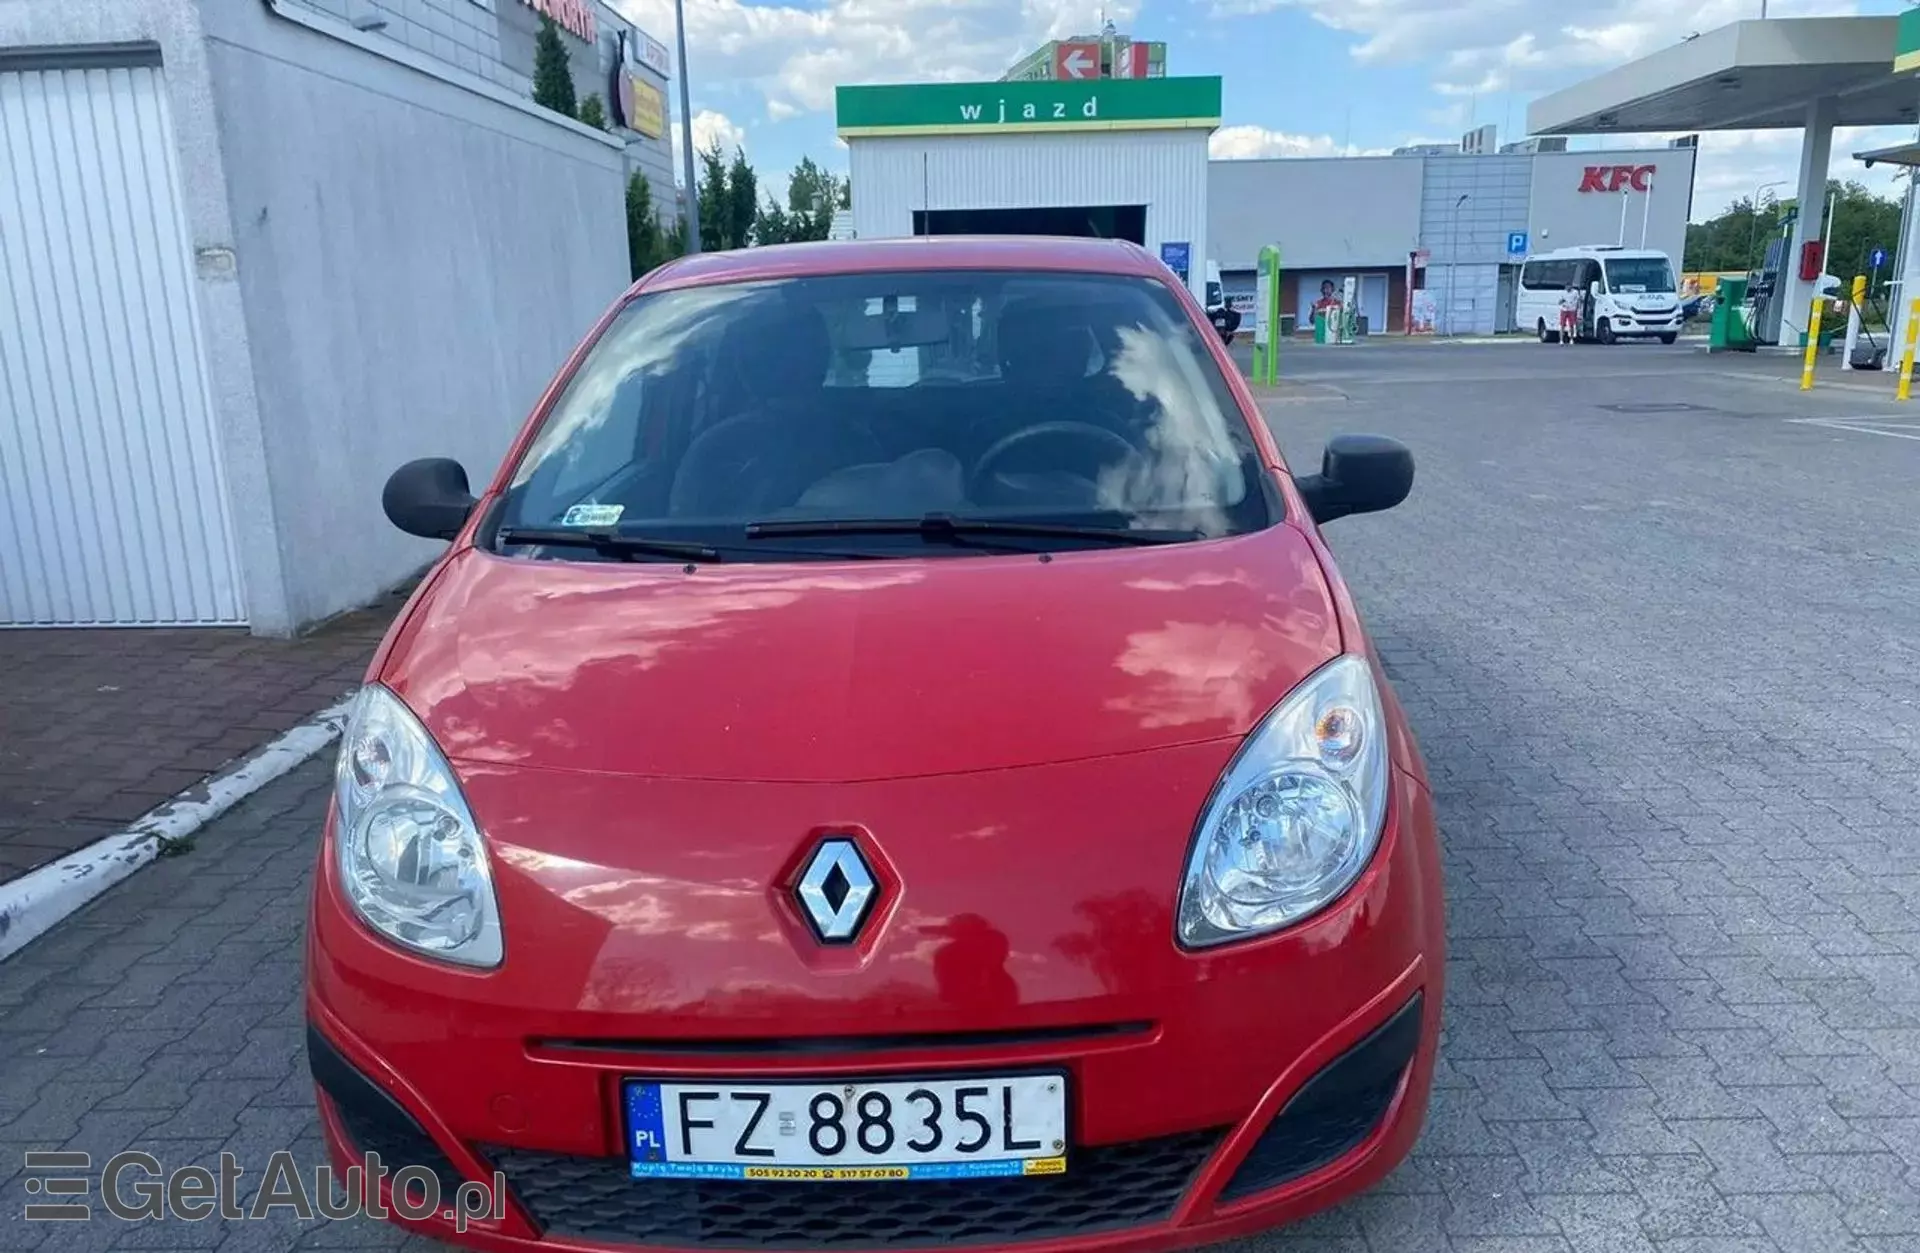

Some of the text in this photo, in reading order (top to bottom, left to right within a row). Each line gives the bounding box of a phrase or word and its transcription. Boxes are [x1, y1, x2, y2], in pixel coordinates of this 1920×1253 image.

[959, 96, 1098, 124] wjazd
[1578, 165, 1656, 193] KFC
[1511, 235, 1524, 251] P
[678, 1086, 1041, 1157] FZ 8835L
[635, 1130, 661, 1149] PL
[750, 1167, 769, 1178] 505
[787, 1168, 801, 1179] 20
[803, 1168, 817, 1179] 20
[840, 1168, 857, 1178] 517
